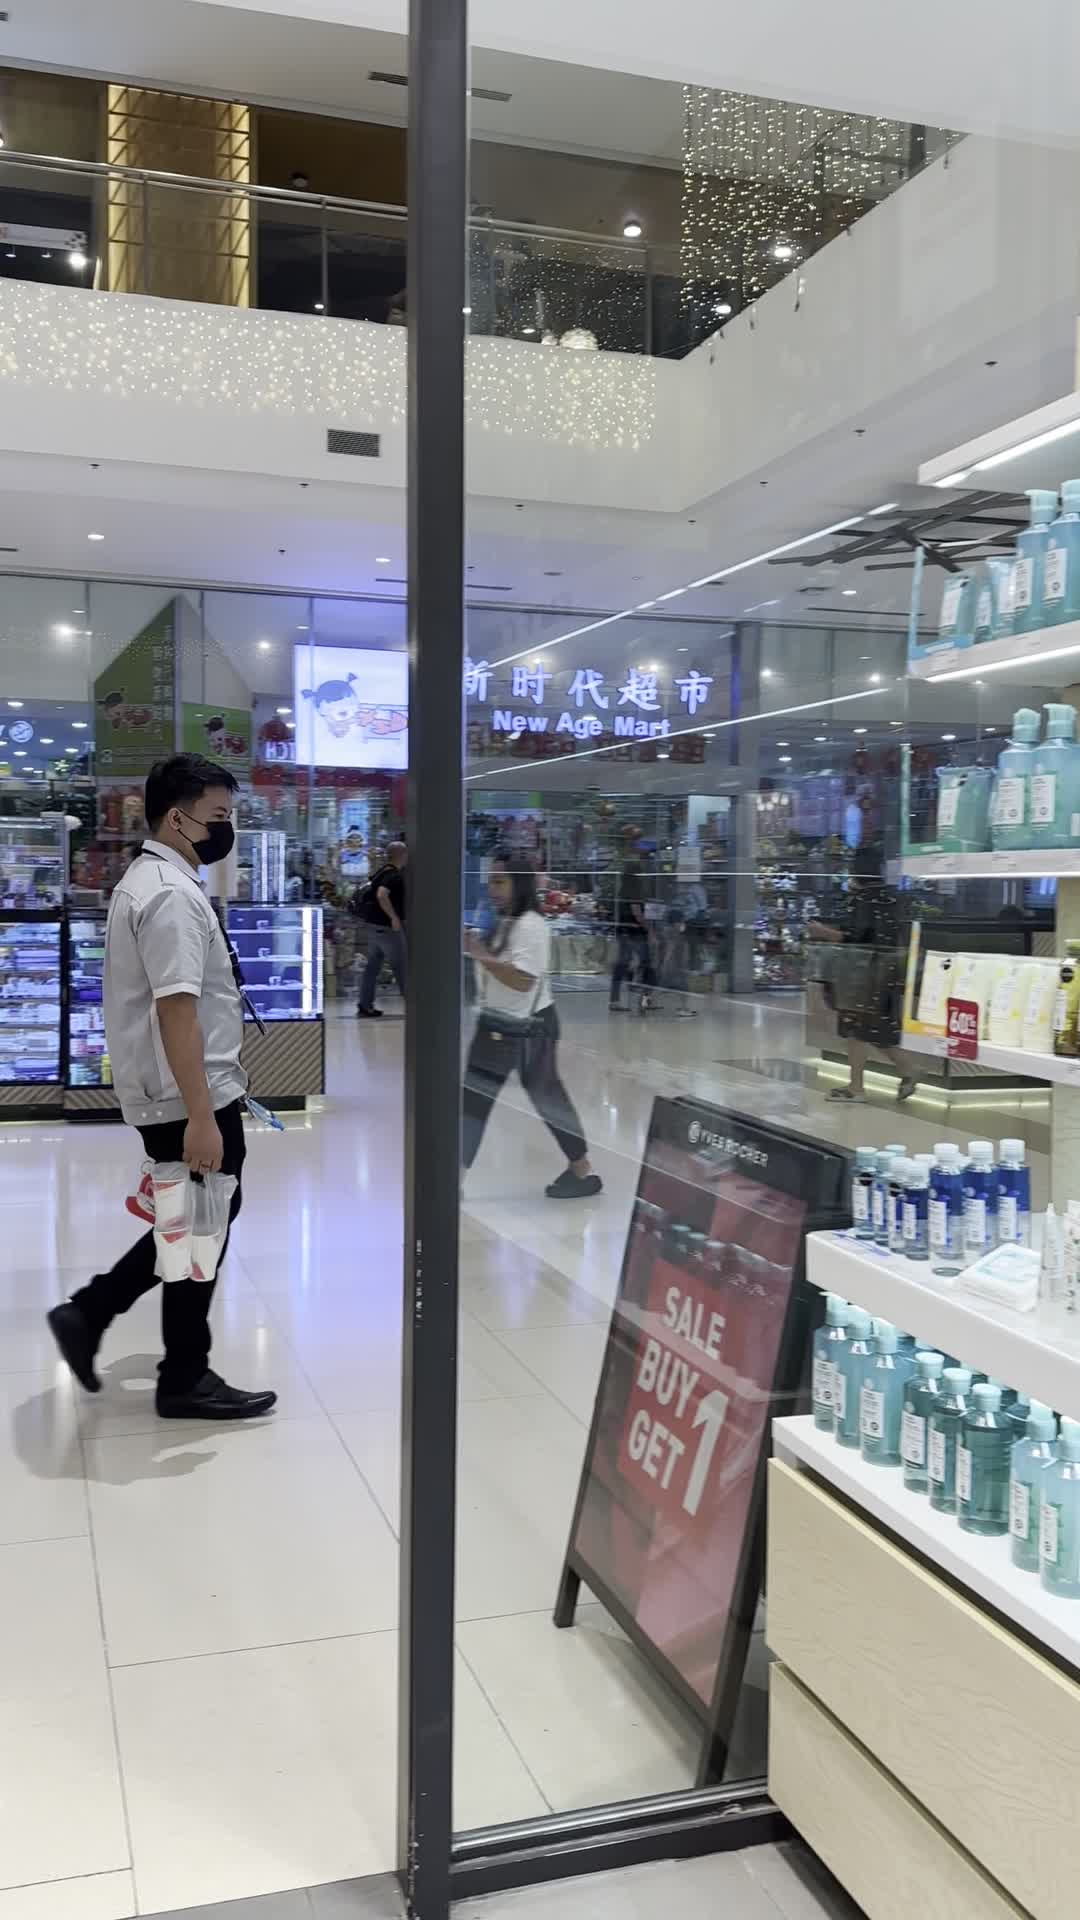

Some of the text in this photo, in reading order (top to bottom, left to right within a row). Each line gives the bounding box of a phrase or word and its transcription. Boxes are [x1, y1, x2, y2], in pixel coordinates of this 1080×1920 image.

[493, 710, 671, 739] New Age Mart
[664, 1287, 726, 1361] SALE
[637, 1339, 700, 1420] BUY
[628, 1409, 686, 1490] GET
[682, 1389, 729, 1517] 1
